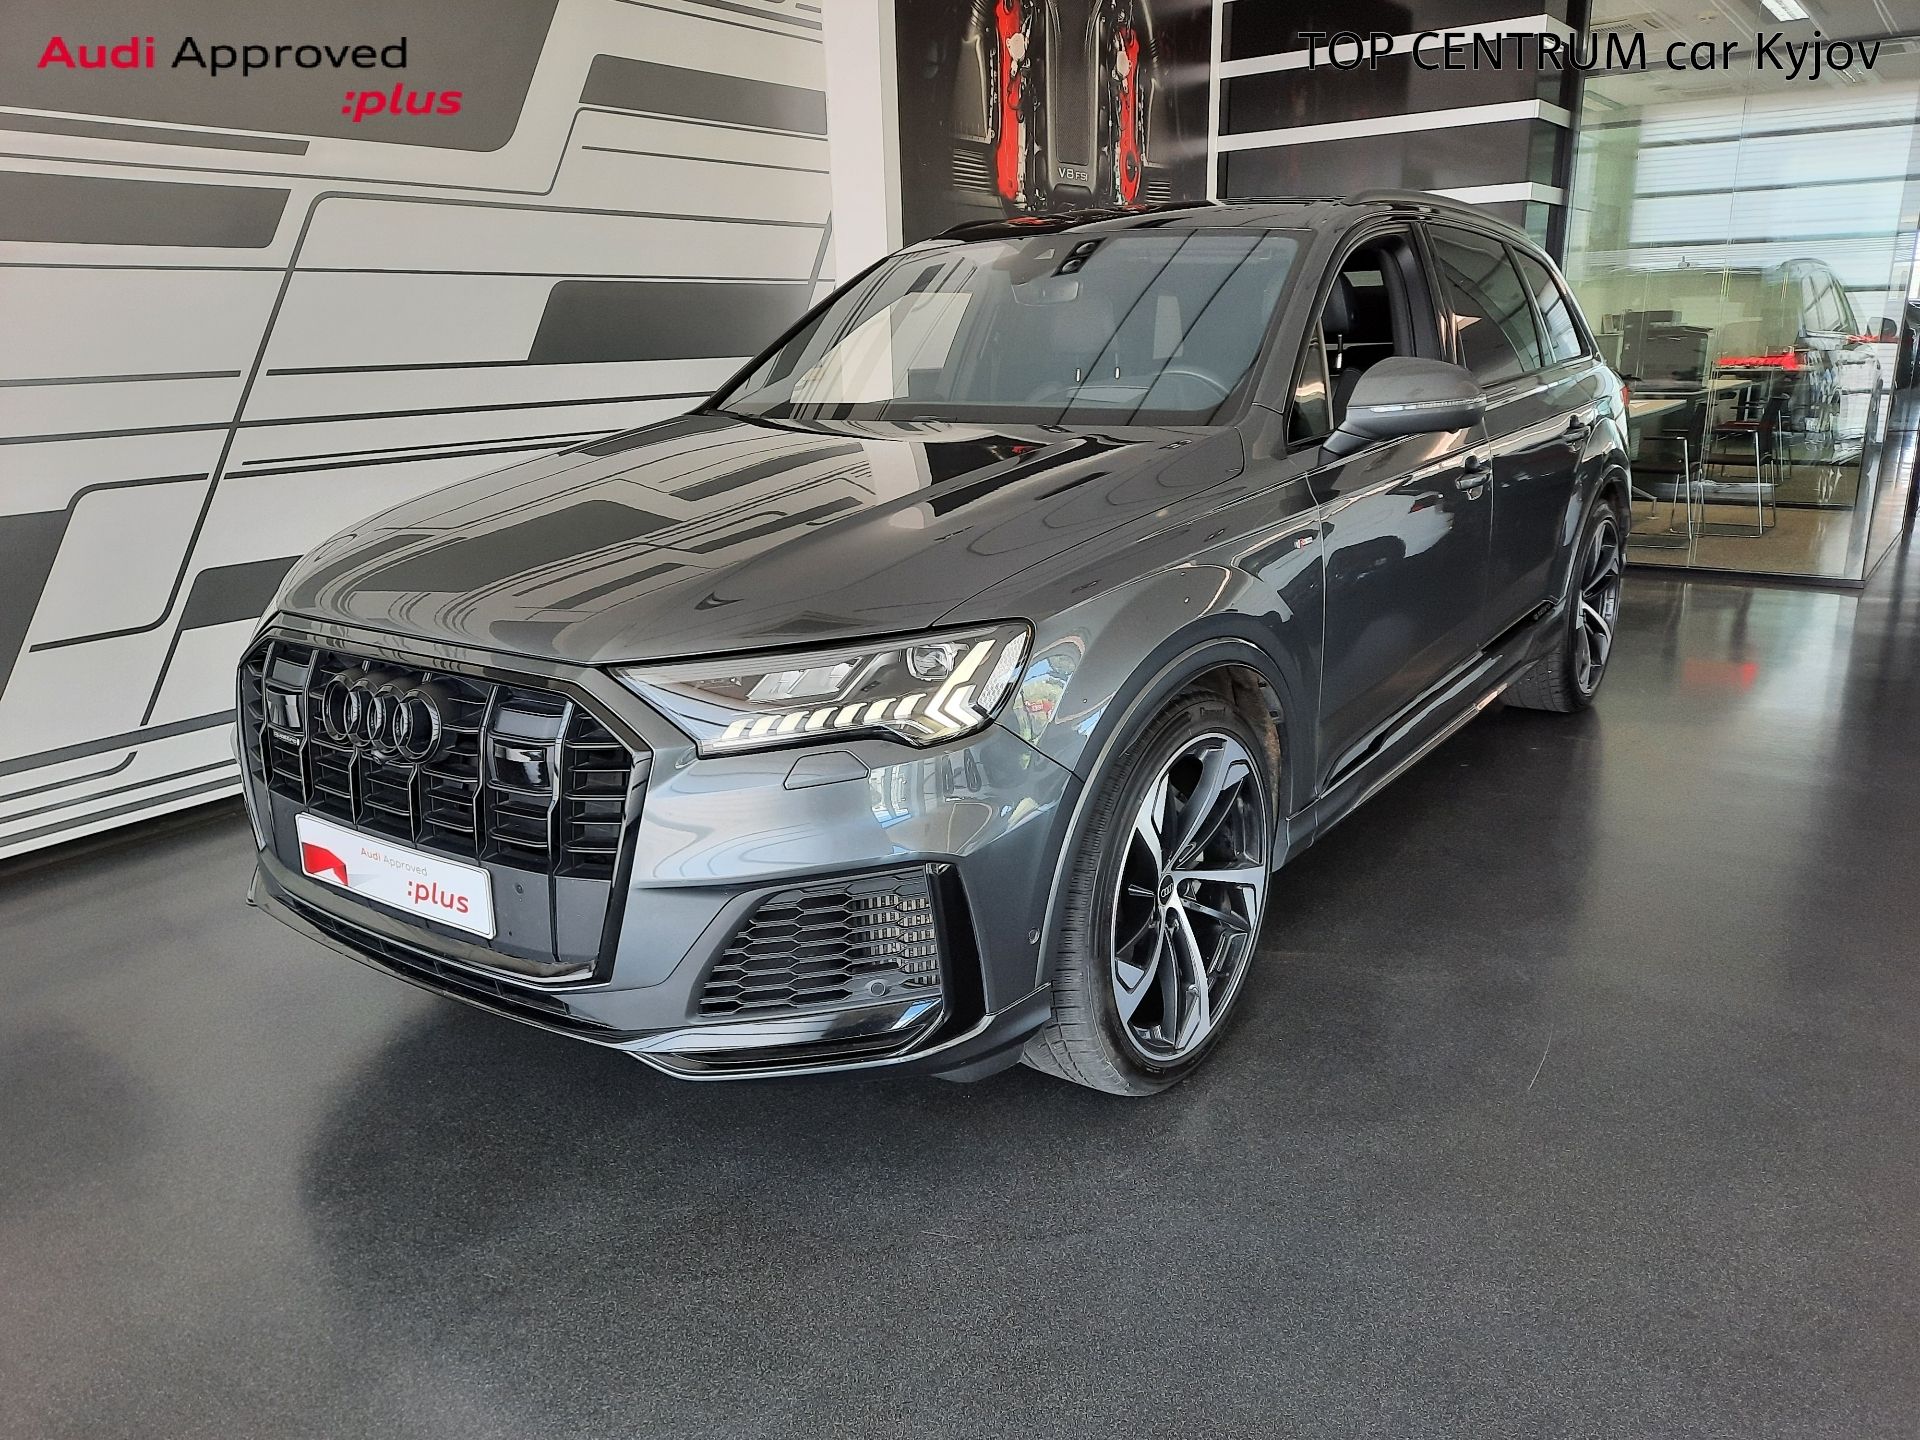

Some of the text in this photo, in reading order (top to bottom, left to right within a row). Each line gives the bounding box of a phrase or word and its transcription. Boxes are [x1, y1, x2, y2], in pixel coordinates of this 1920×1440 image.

[360, 847, 428, 877] Audi Approved
[407, 880, 469, 914] :plus
